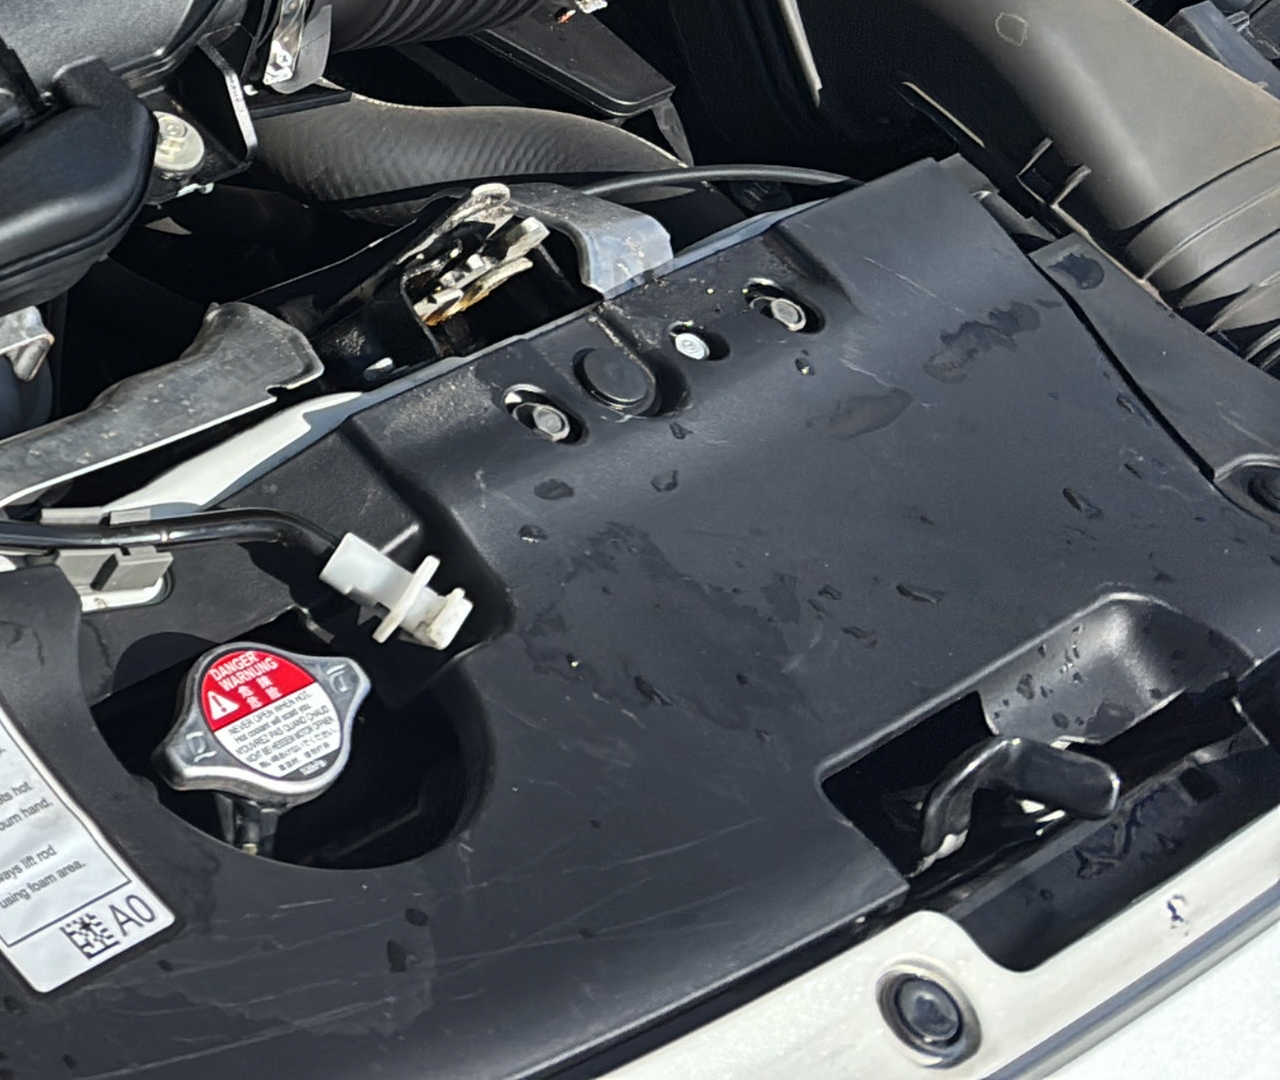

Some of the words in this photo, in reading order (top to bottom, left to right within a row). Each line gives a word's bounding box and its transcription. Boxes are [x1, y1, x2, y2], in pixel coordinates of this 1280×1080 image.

[208, 650, 260, 681] DANGER
[218, 657, 279, 692] WARNUNG
[228, 718, 255, 735] NEVER
[254, 709, 274, 725] OPEN
[274, 698, 297, 716] WHEN
[269, 725, 284, 741] PAS
[283, 715, 307, 734] QUAND
[306, 704, 330, 722] CHAUD
[12, 780, 32, 797] hot
[21, 797, 54, 820] hand.
[22, 855, 38, 872] lift
[37, 844, 58, 862] rod
[27, 873, 58, 895] foam
[56, 858, 87, 880] area.
